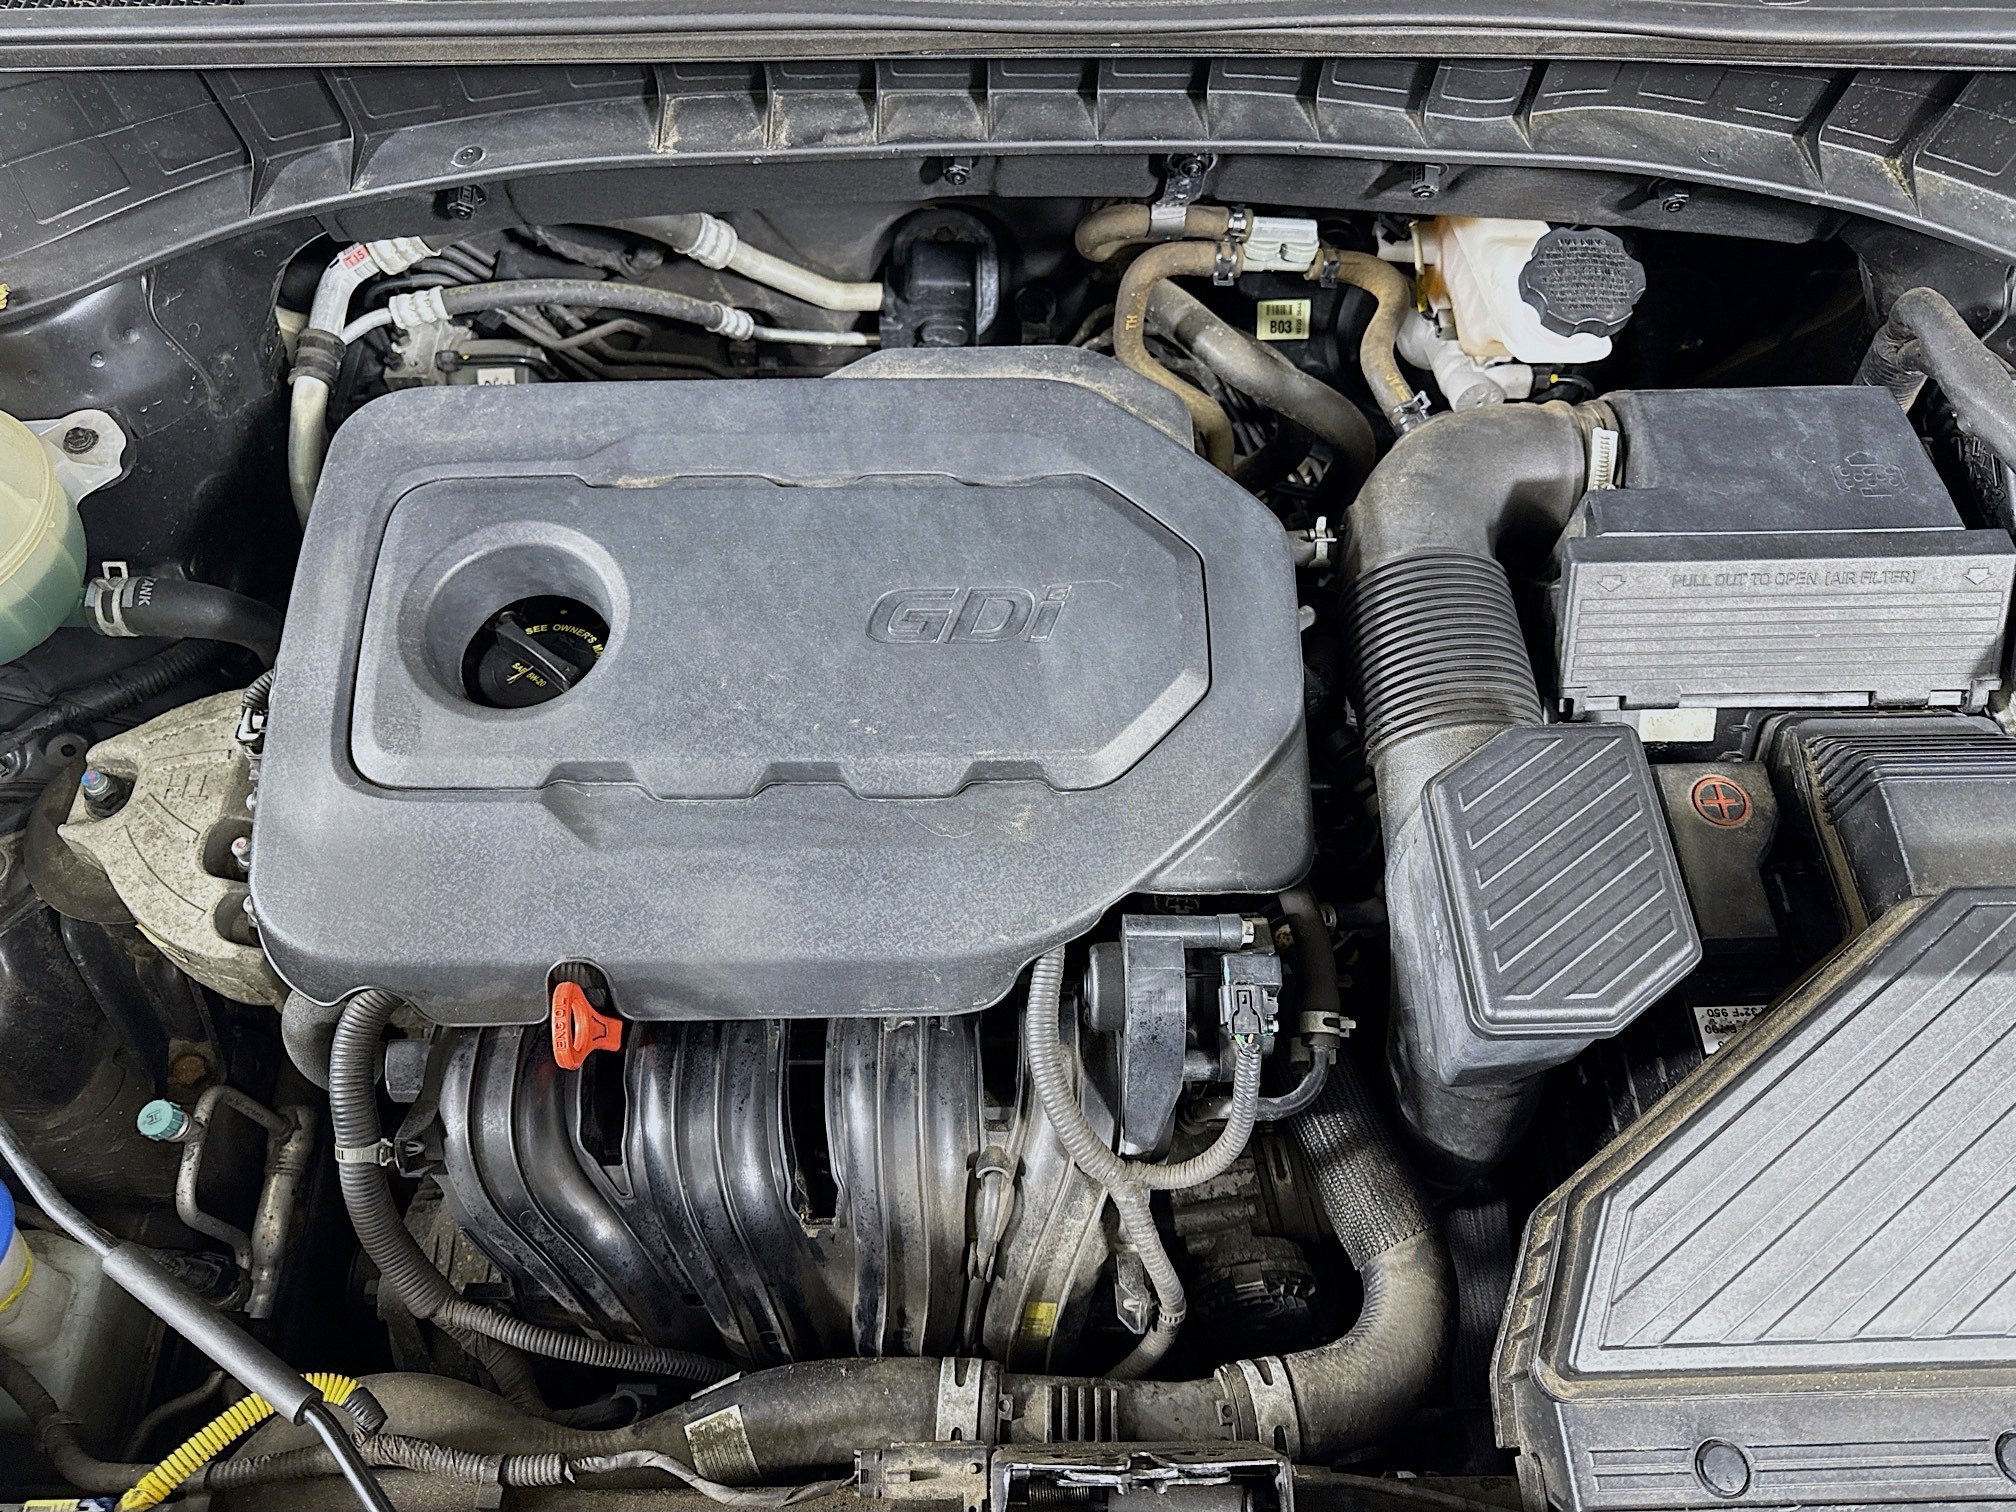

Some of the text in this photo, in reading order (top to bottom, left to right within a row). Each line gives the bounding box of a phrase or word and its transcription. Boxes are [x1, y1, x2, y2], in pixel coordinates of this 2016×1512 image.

[1671, 572, 1711, 588] PULL
[1714, 572, 1748, 587] OUT
[1751, 572, 1770, 586] TO
[1774, 571, 1819, 586] OPEN
[865, 585, 1073, 644] GDi
[525, 624, 548, 635] SEE
[552, 623, 598, 644] OWNER'S
[525, 671, 547, 688] 5W-20
[1706, 1008, 1729, 1018] 950
